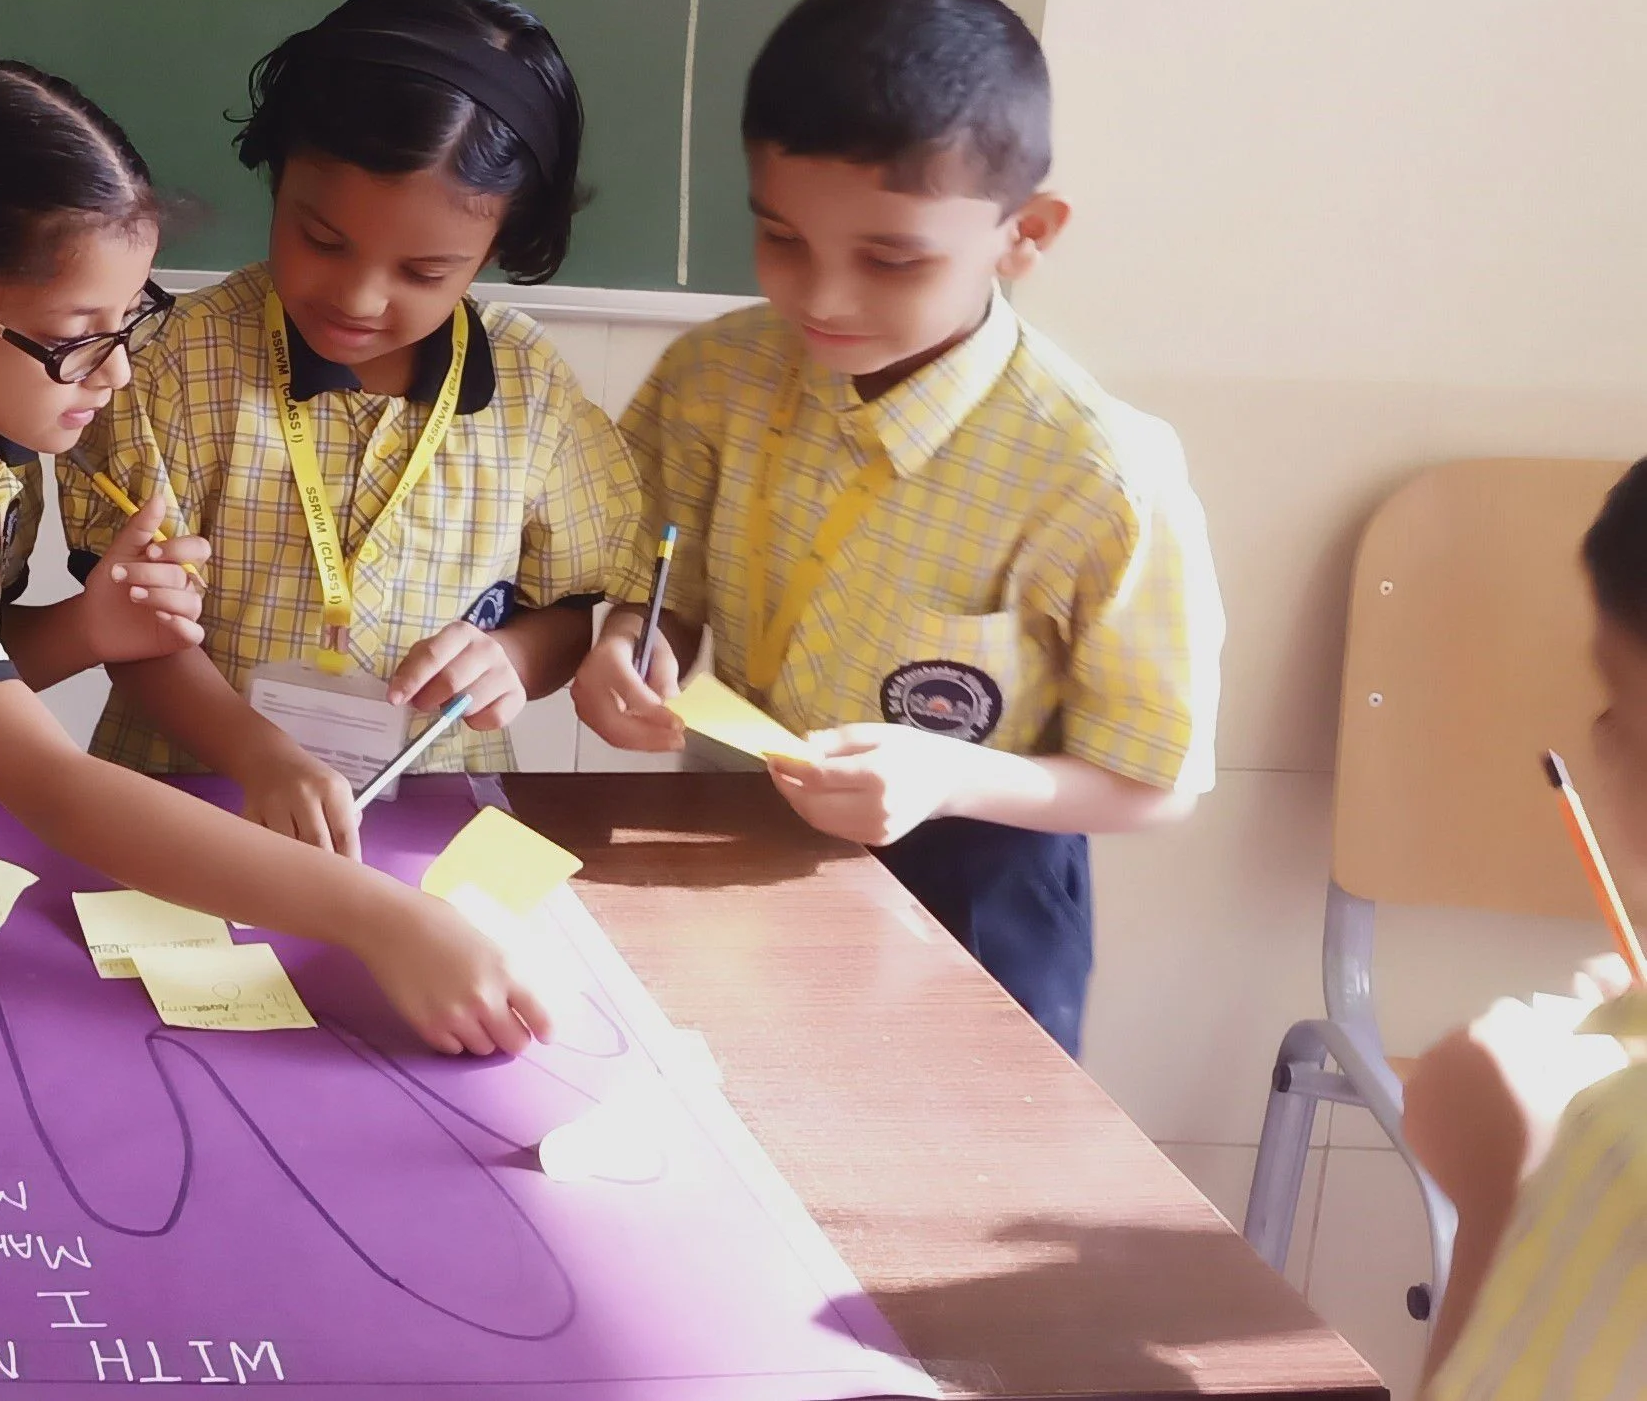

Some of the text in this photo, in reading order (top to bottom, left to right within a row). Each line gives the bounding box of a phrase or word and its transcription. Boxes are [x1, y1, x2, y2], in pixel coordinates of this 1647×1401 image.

[271, 329, 291, 376] SSRVM
[279, 382, 303, 431] (CLASS
[426, 398, 452, 445] SSRVM
[305, 485, 328, 535] SSRVM
[317, 540, 341, 591] (CLASS
[37, 1290, 108, 1329] I
[90, 1340, 284, 1385] WITH
